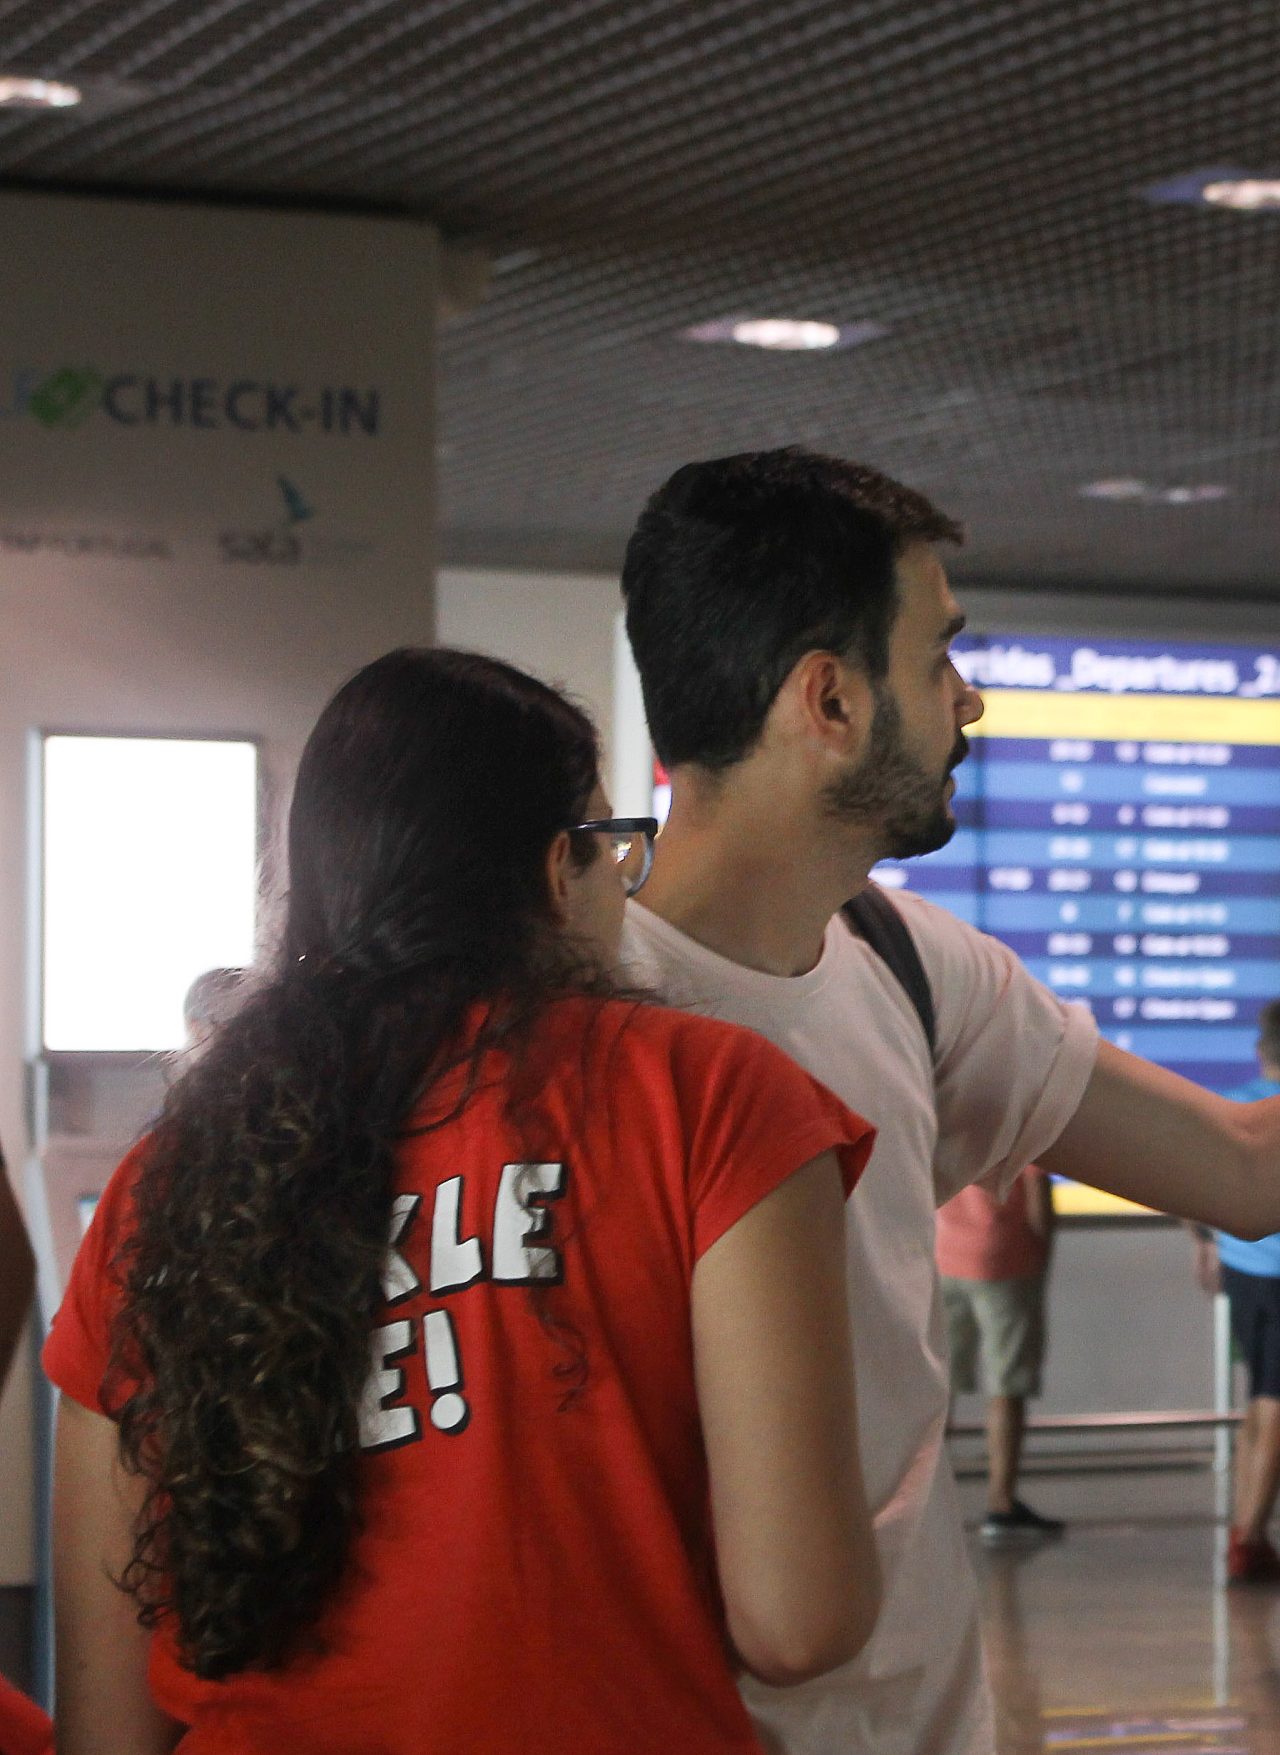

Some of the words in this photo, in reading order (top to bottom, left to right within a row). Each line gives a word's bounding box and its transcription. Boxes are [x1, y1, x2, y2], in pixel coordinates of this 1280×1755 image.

[103, 374, 381, 436] CHECK-IN
[380, 1162, 566, 1306] KLE
[356, 1308, 472, 1450] E!
